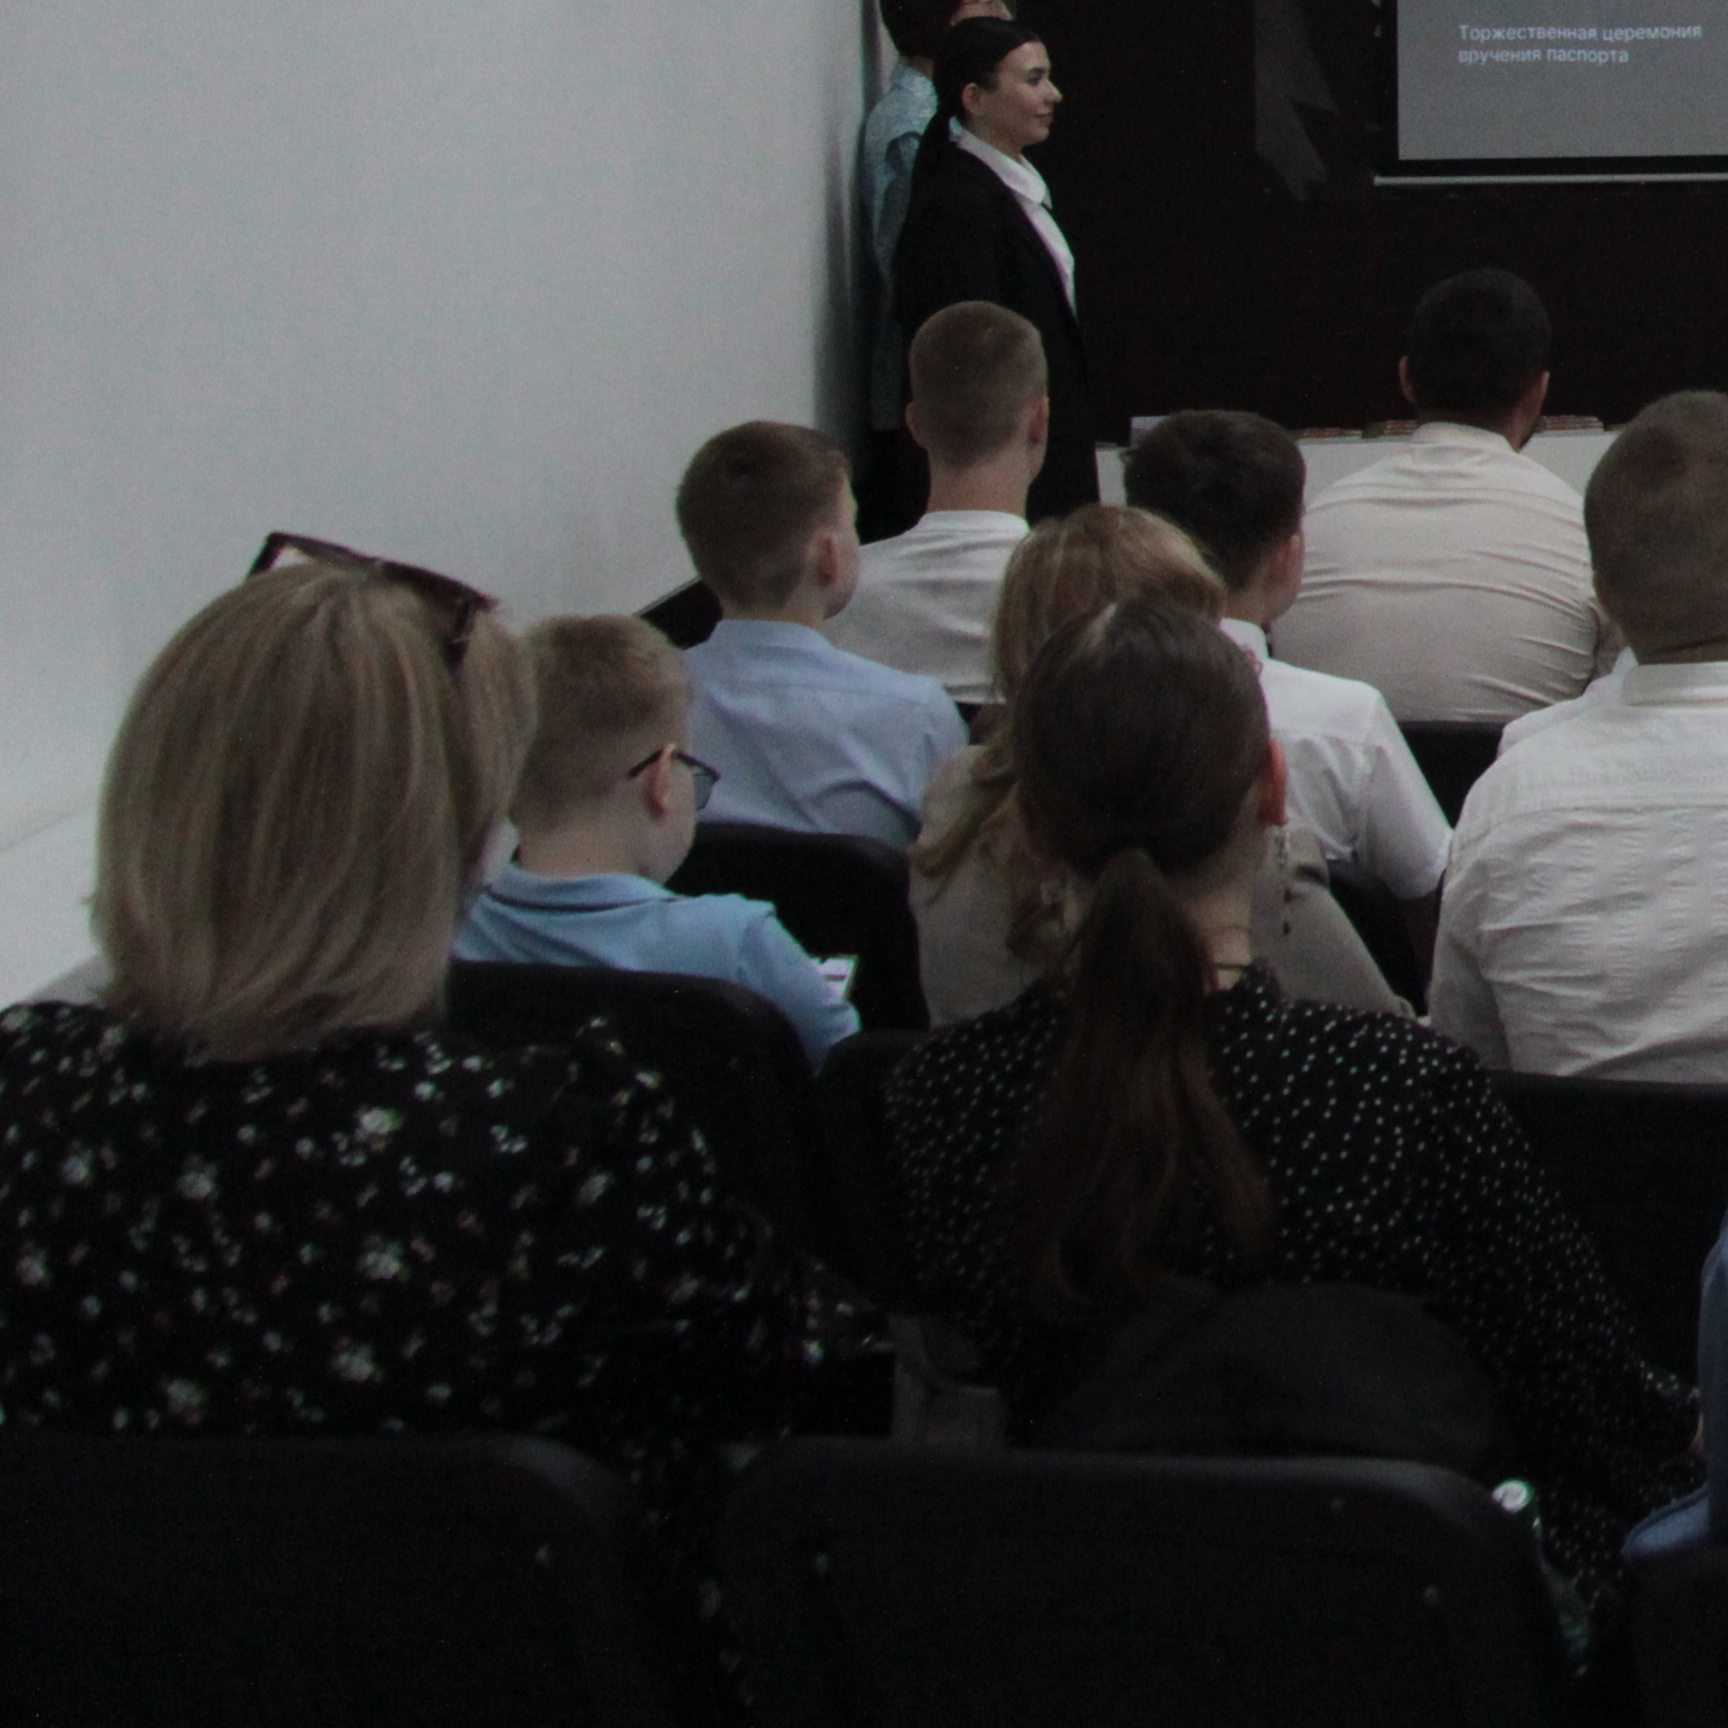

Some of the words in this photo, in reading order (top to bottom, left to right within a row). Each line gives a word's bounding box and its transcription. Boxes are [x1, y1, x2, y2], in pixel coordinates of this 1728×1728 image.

[1458, 22, 1598, 45] Торжественная
[1602, 22, 1702, 43] церемония
[1458, 46, 1542, 66] вручения
[1546, 46, 1629, 67] паспорта
